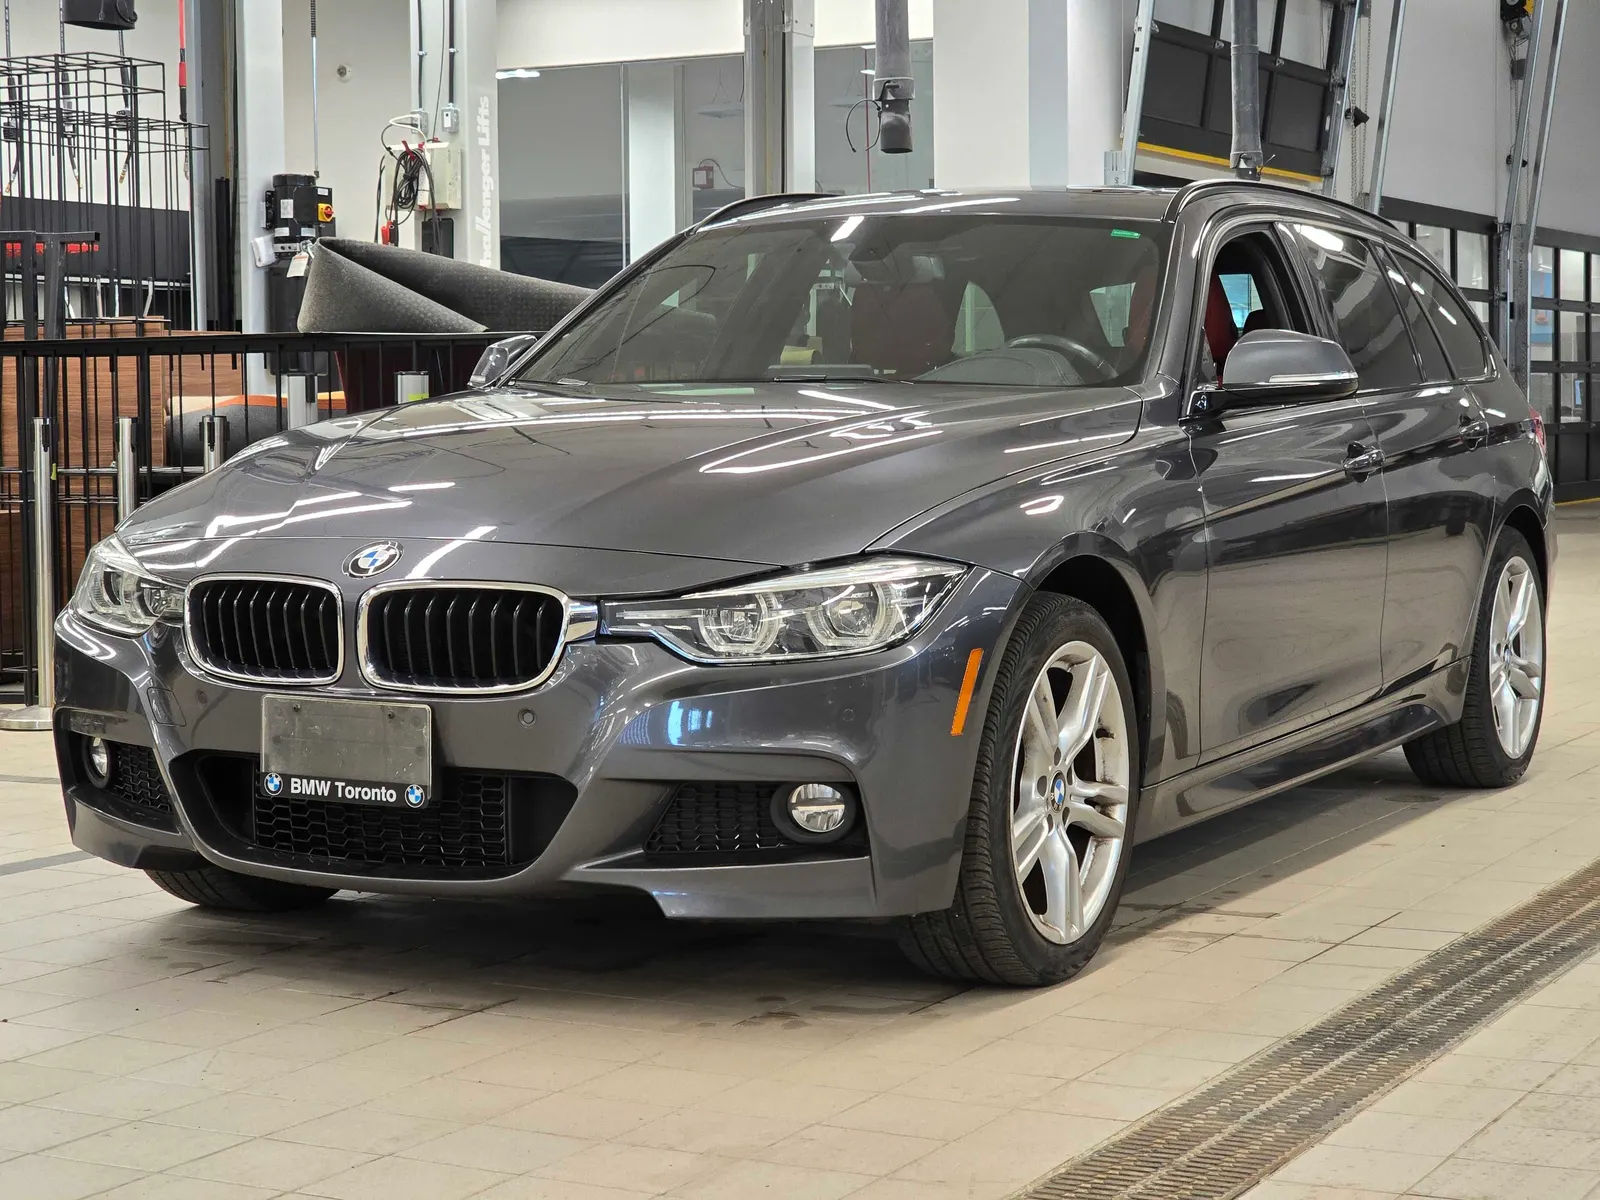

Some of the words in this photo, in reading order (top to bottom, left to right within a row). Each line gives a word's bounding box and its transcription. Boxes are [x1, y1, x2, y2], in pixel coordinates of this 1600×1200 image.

[477, 96, 490, 146] Lifts
[475, 148, 494, 267] hallenger
[290, 778, 331, 796] BMW
[335, 781, 397, 802] Toronto
